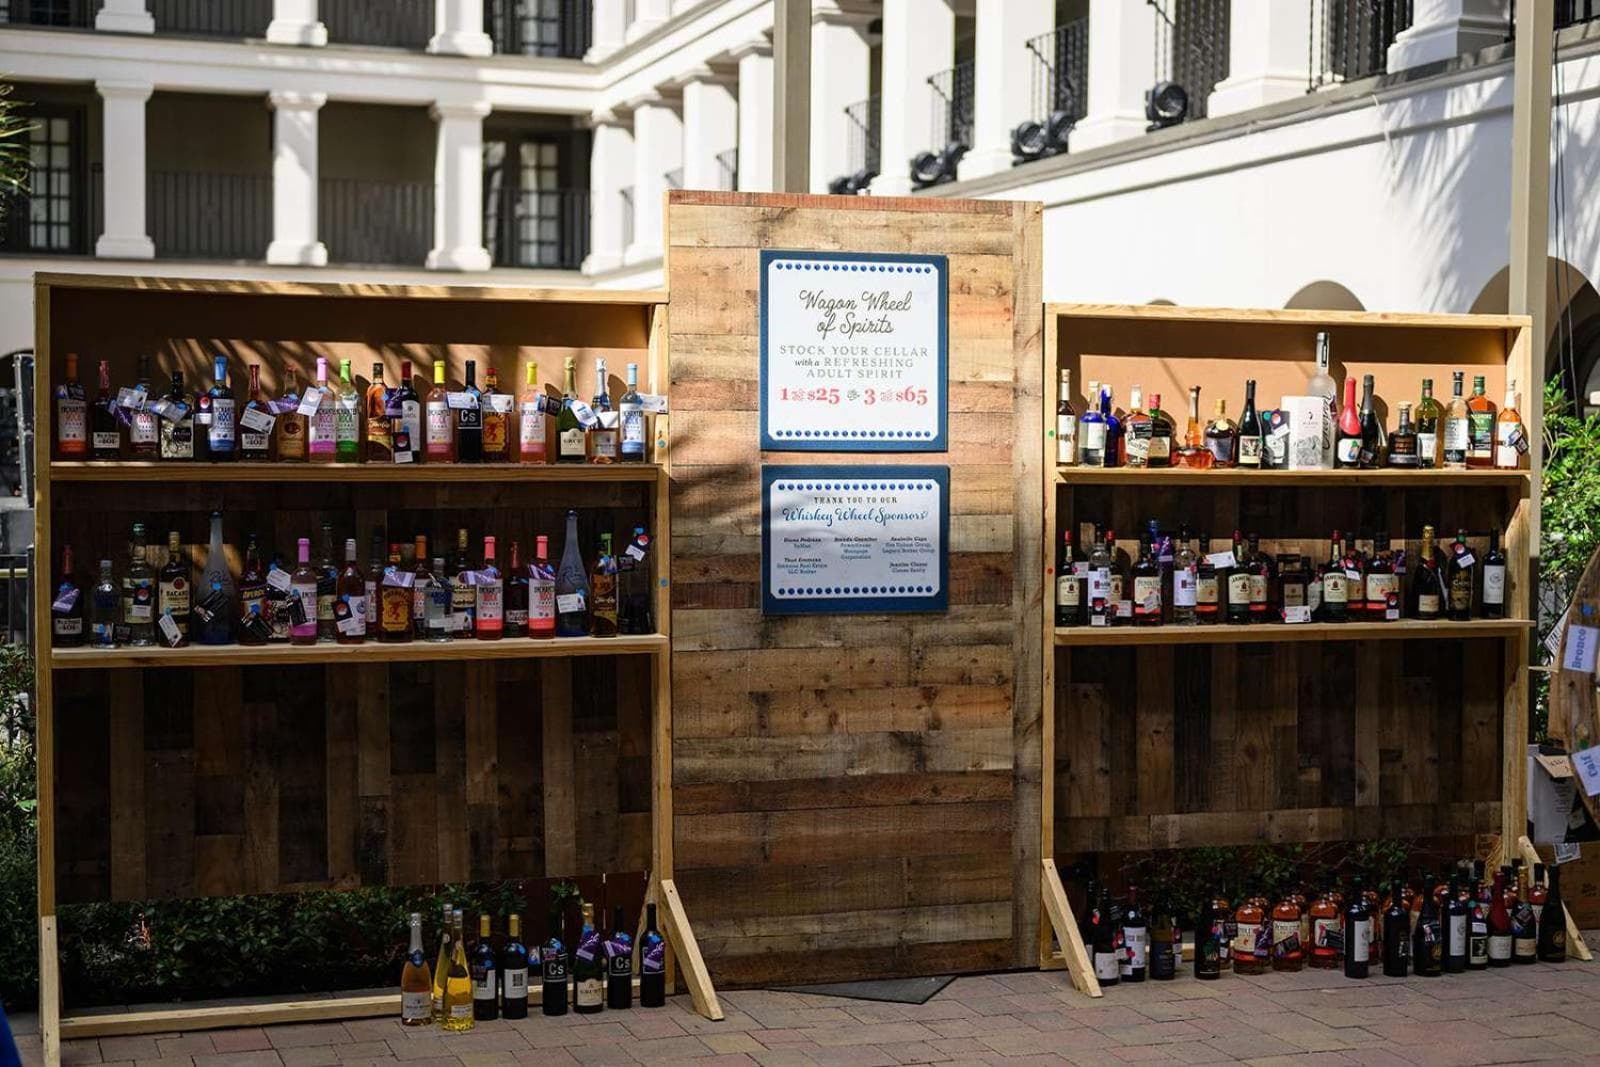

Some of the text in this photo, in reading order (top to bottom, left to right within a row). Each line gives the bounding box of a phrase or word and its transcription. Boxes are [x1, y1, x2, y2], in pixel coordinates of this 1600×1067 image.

[799, 289, 913, 318] Wagon Wheel
[816, 311, 894, 341] of Spirits
[780, 345, 928, 357] STOCK YOUR CELLAR
[795, 358, 813, 367] with
[823, 357, 914, 368] REFRESHING
[806, 369, 904, 379] ADULT SPIRIT
[781, 388, 789, 401] 1
[807, 387, 841, 405] $25
[864, 388, 876, 405] 3
[895, 385, 928, 406] $65
[460, 409, 477, 422] Cs
[814, 496, 897, 504] THANK YOU TO OUR
[782, 507, 833, 527] Whiskey
[834, 507, 874, 521] Wheel
[1571, 628, 1587, 669] Bronco
[548, 962, 565, 975] Cs
[615, 956, 631, 969] Cs
